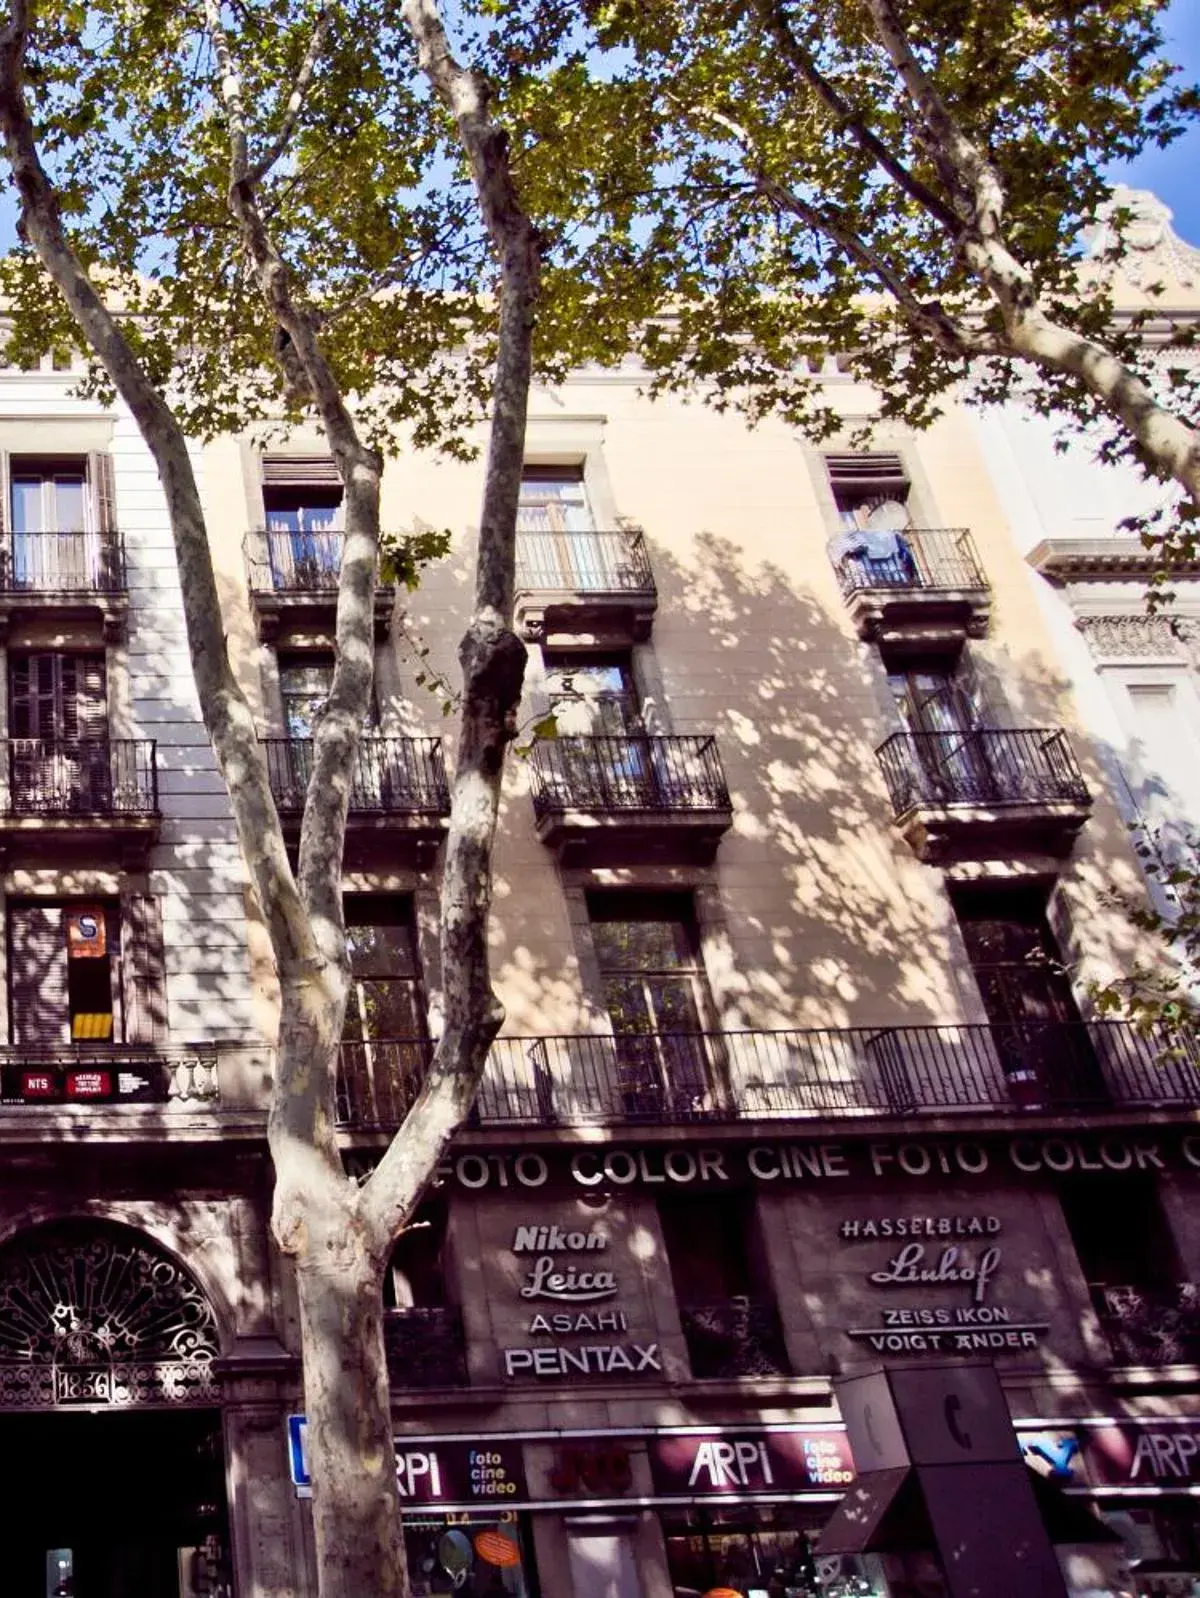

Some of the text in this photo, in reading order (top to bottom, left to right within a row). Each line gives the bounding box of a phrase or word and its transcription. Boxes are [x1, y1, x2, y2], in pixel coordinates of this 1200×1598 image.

[570, 1149, 730, 1186] COLOR
[747, 1145, 850, 1180] CINE
[870, 1141, 990, 1177] FOTO
[1007, 1138, 1166, 1173] COLOR
[513, 1225, 608, 1252] Nikon
[841, 1215, 1001, 1238] HASSELBLAD
[520, 1256, 618, 1301] Leica
[871, 1243, 1001, 1302] Linhof
[529, 1312, 628, 1334] ASAHI
[884, 1307, 1010, 1326] ZEISS IKON
[870, 1334, 942, 1352] VOIGT
[504, 1343, 662, 1377] PENTAX
[60, 1371, 109, 1398] 1856
[469, 1450, 502, 1465] foto
[688, 1440, 774, 1487] ARPI
[1129, 1433, 1200, 1479] ARP
[394, 1451, 442, 1497] RPI
[471, 1465, 506, 1480] cine
[808, 1469, 853, 1484] video
[472, 1480, 517, 1495] video
